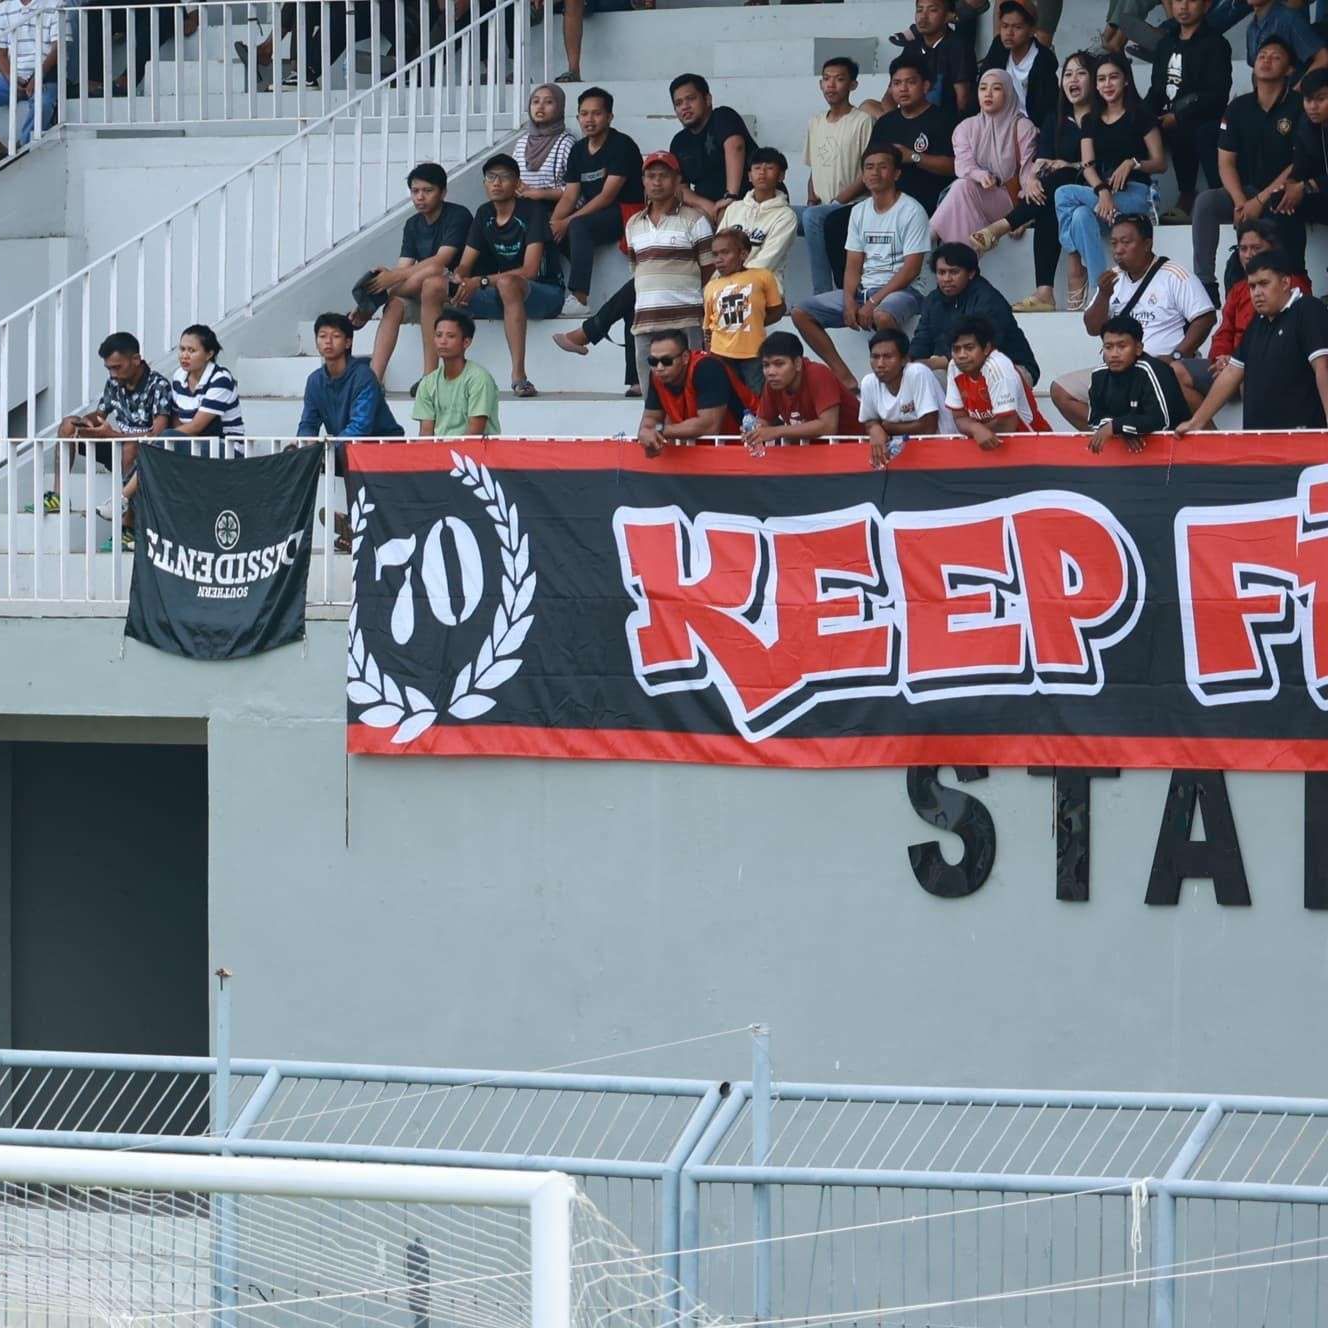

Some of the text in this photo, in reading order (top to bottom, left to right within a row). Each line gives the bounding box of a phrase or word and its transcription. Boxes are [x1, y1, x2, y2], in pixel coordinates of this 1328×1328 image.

[197, 586, 248, 598] SOUTHERN
[374, 516, 484, 645] 70
[612, 490, 1146, 742] KEEP
[906, 765, 1328, 909] STA
